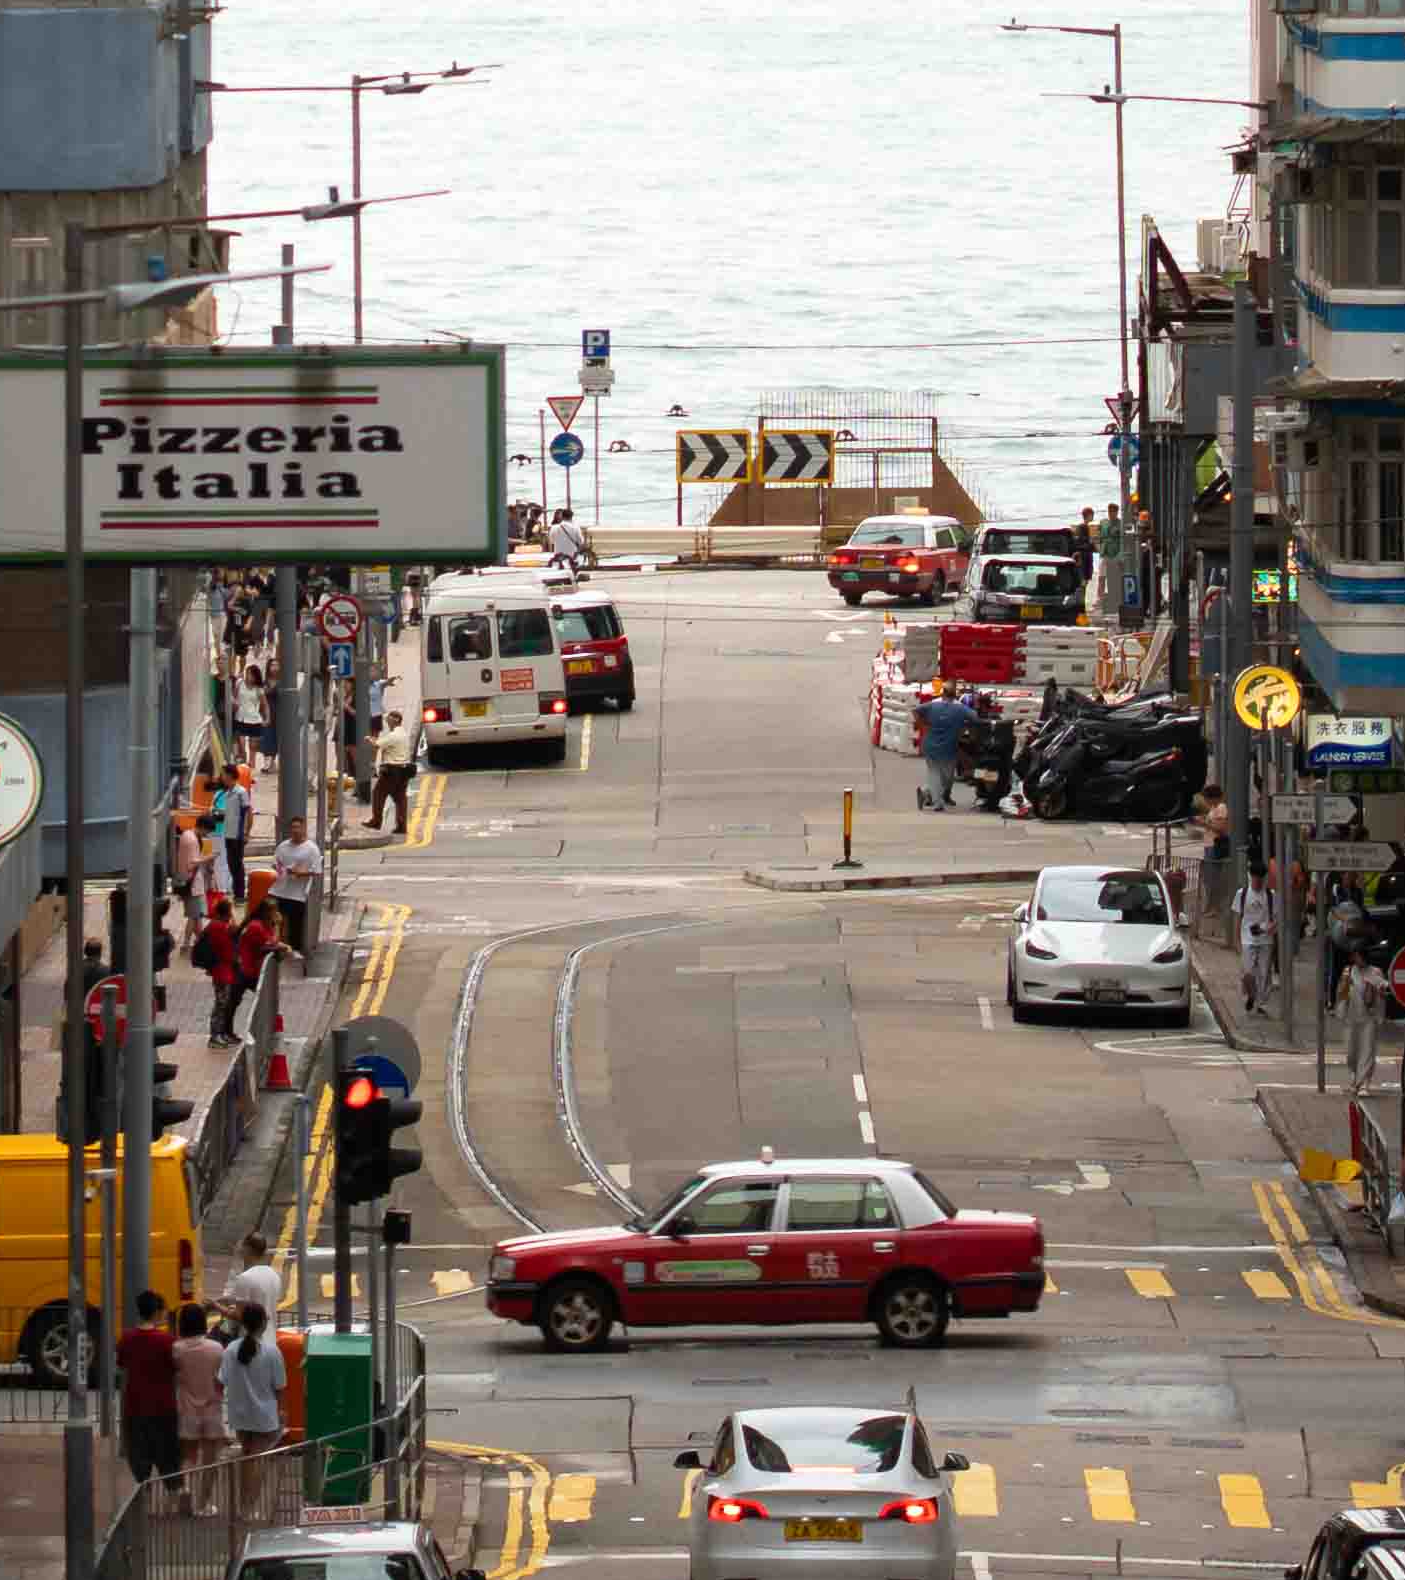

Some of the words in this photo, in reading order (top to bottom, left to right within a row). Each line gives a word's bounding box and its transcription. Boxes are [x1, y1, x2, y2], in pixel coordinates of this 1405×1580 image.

[587, 332, 605, 355] P
[81, 414, 404, 455] Pizzeria
[117, 462, 362, 500] Italia
[1316, 720, 1385, 737] 洗衣服務
[1315, 751, 1350, 763] LAUNDRY
[1352, 750, 1386, 762] SERVICE
